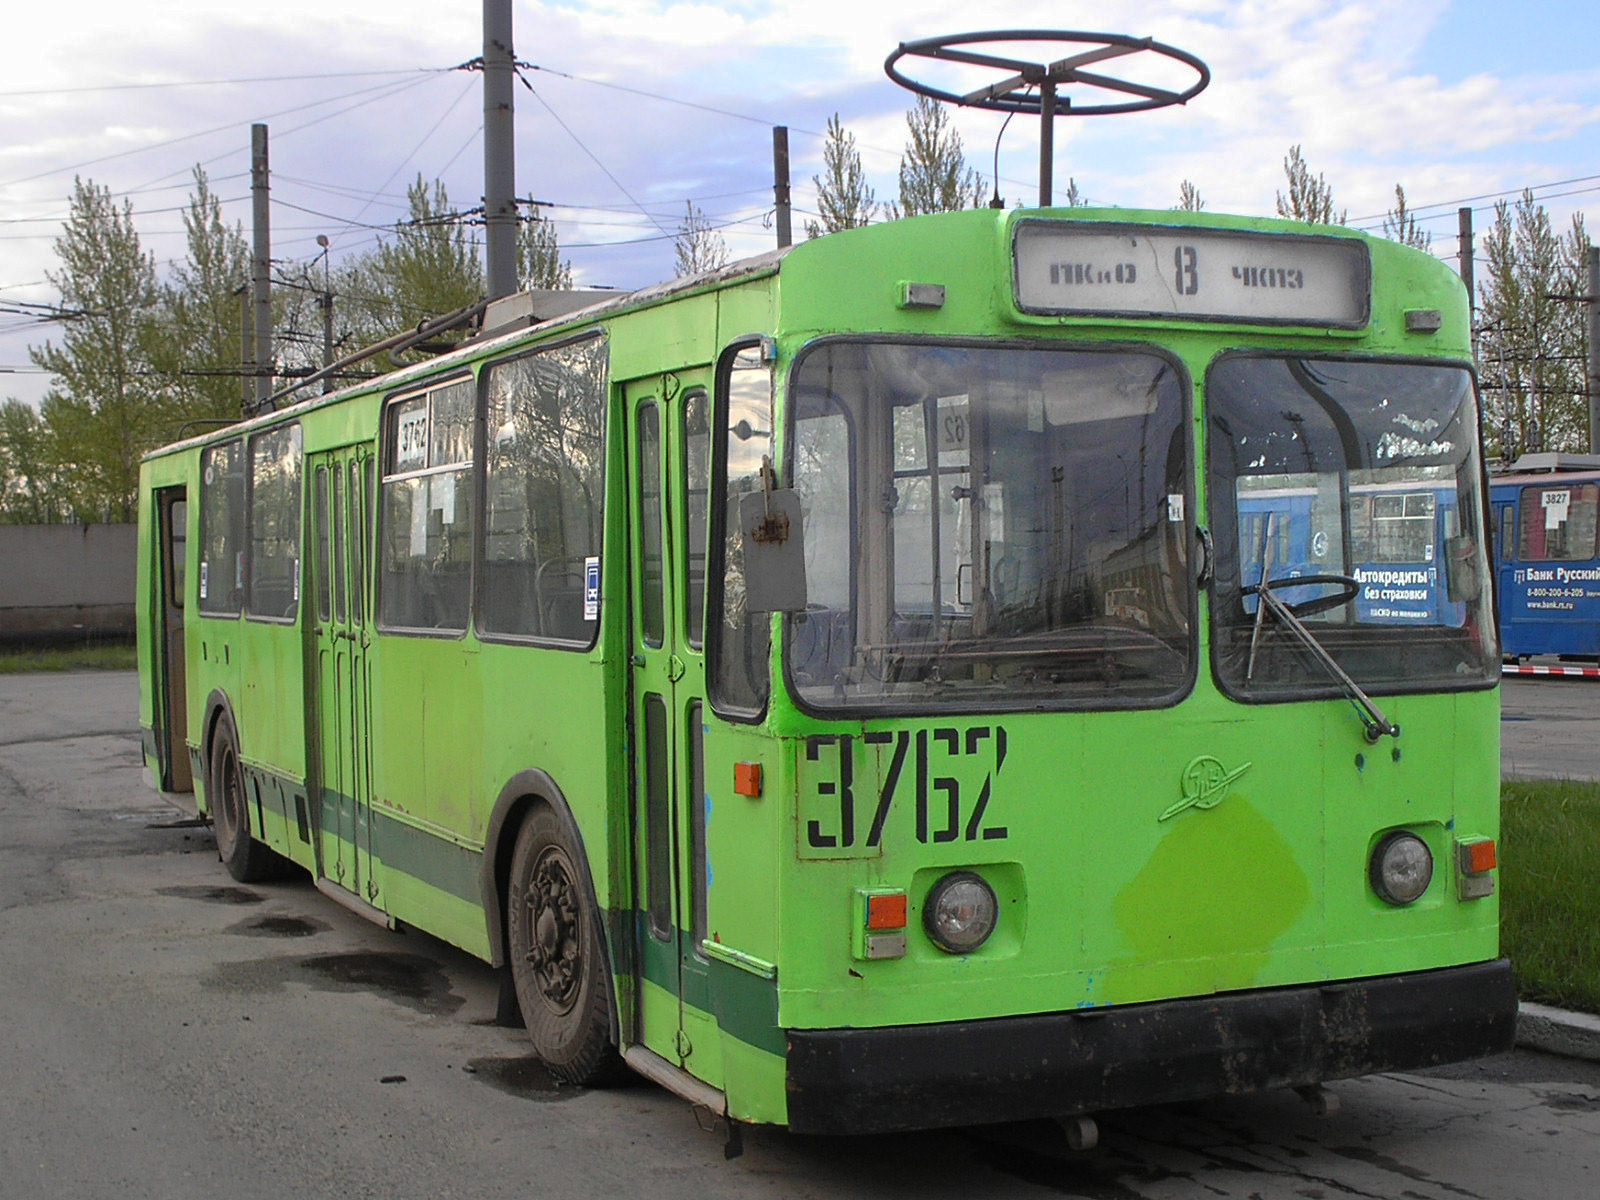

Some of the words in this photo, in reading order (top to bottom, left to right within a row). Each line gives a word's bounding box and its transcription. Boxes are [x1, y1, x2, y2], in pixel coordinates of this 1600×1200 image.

[1174, 246, 1198, 295] 8
[1231, 266, 1303, 289] ЧКПЗ
[402, 418, 426, 451] 3762
[1545, 493, 1567, 504] 3827
[1353, 568, 1427, 587] Автокредиты
[1526, 568, 1554, 580] Банк
[1557, 567, 1600, 584] Русский
[1364, 586, 1379, 600] без
[1381, 589, 1427, 602] страховки
[806, 726, 1008, 847] 3762
